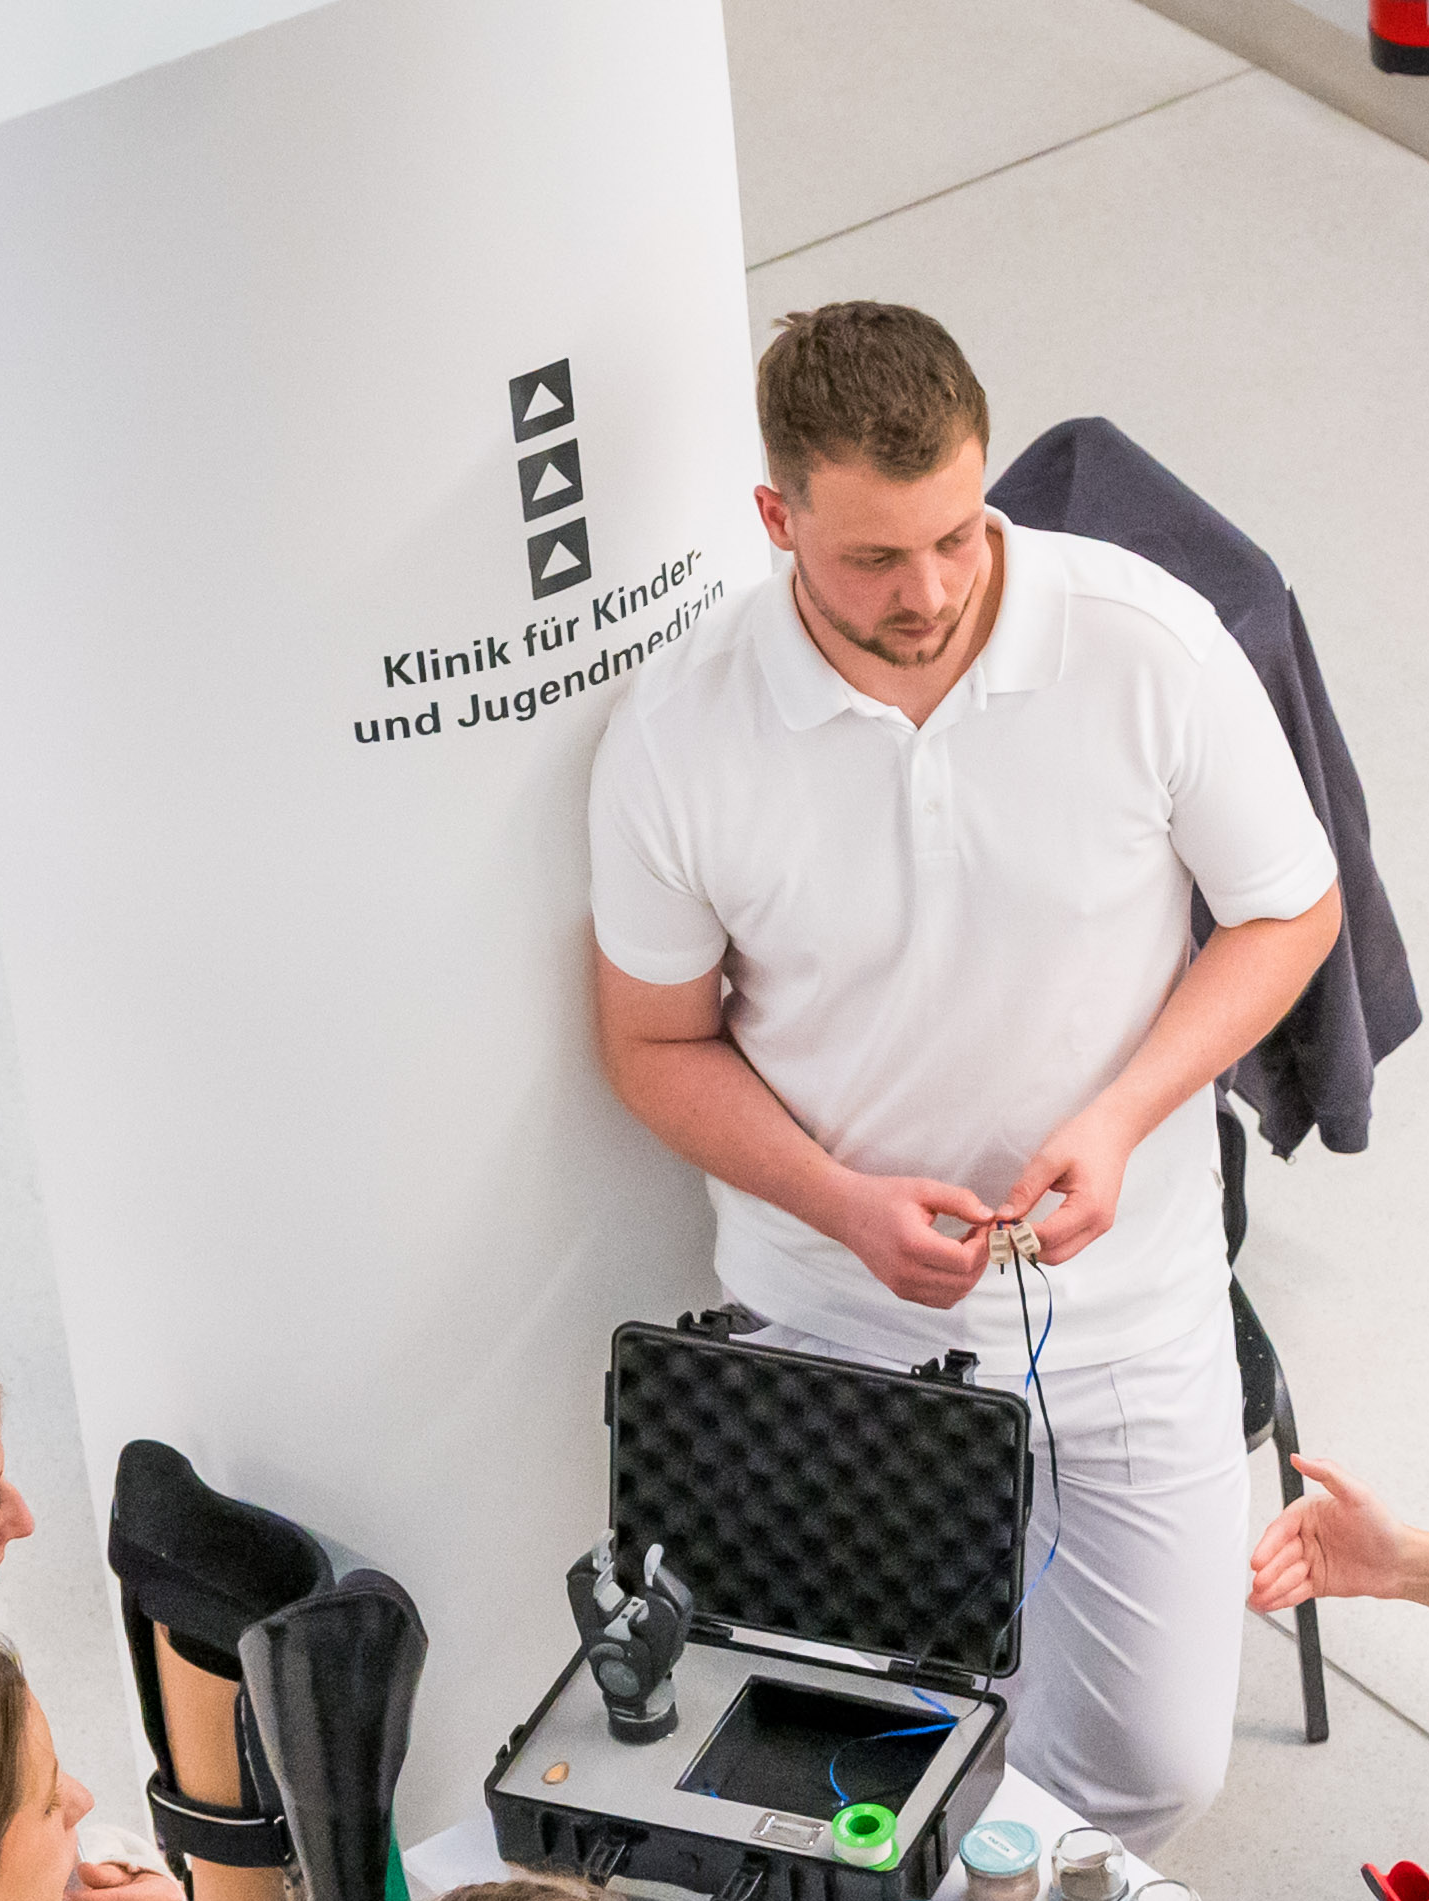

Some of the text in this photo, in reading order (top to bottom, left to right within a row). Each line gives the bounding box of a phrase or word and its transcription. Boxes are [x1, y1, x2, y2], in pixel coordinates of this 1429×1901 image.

[354, 576, 725, 744] und Jugendmedizin
[383, 548, 703, 688] Klinik für Kinder-
